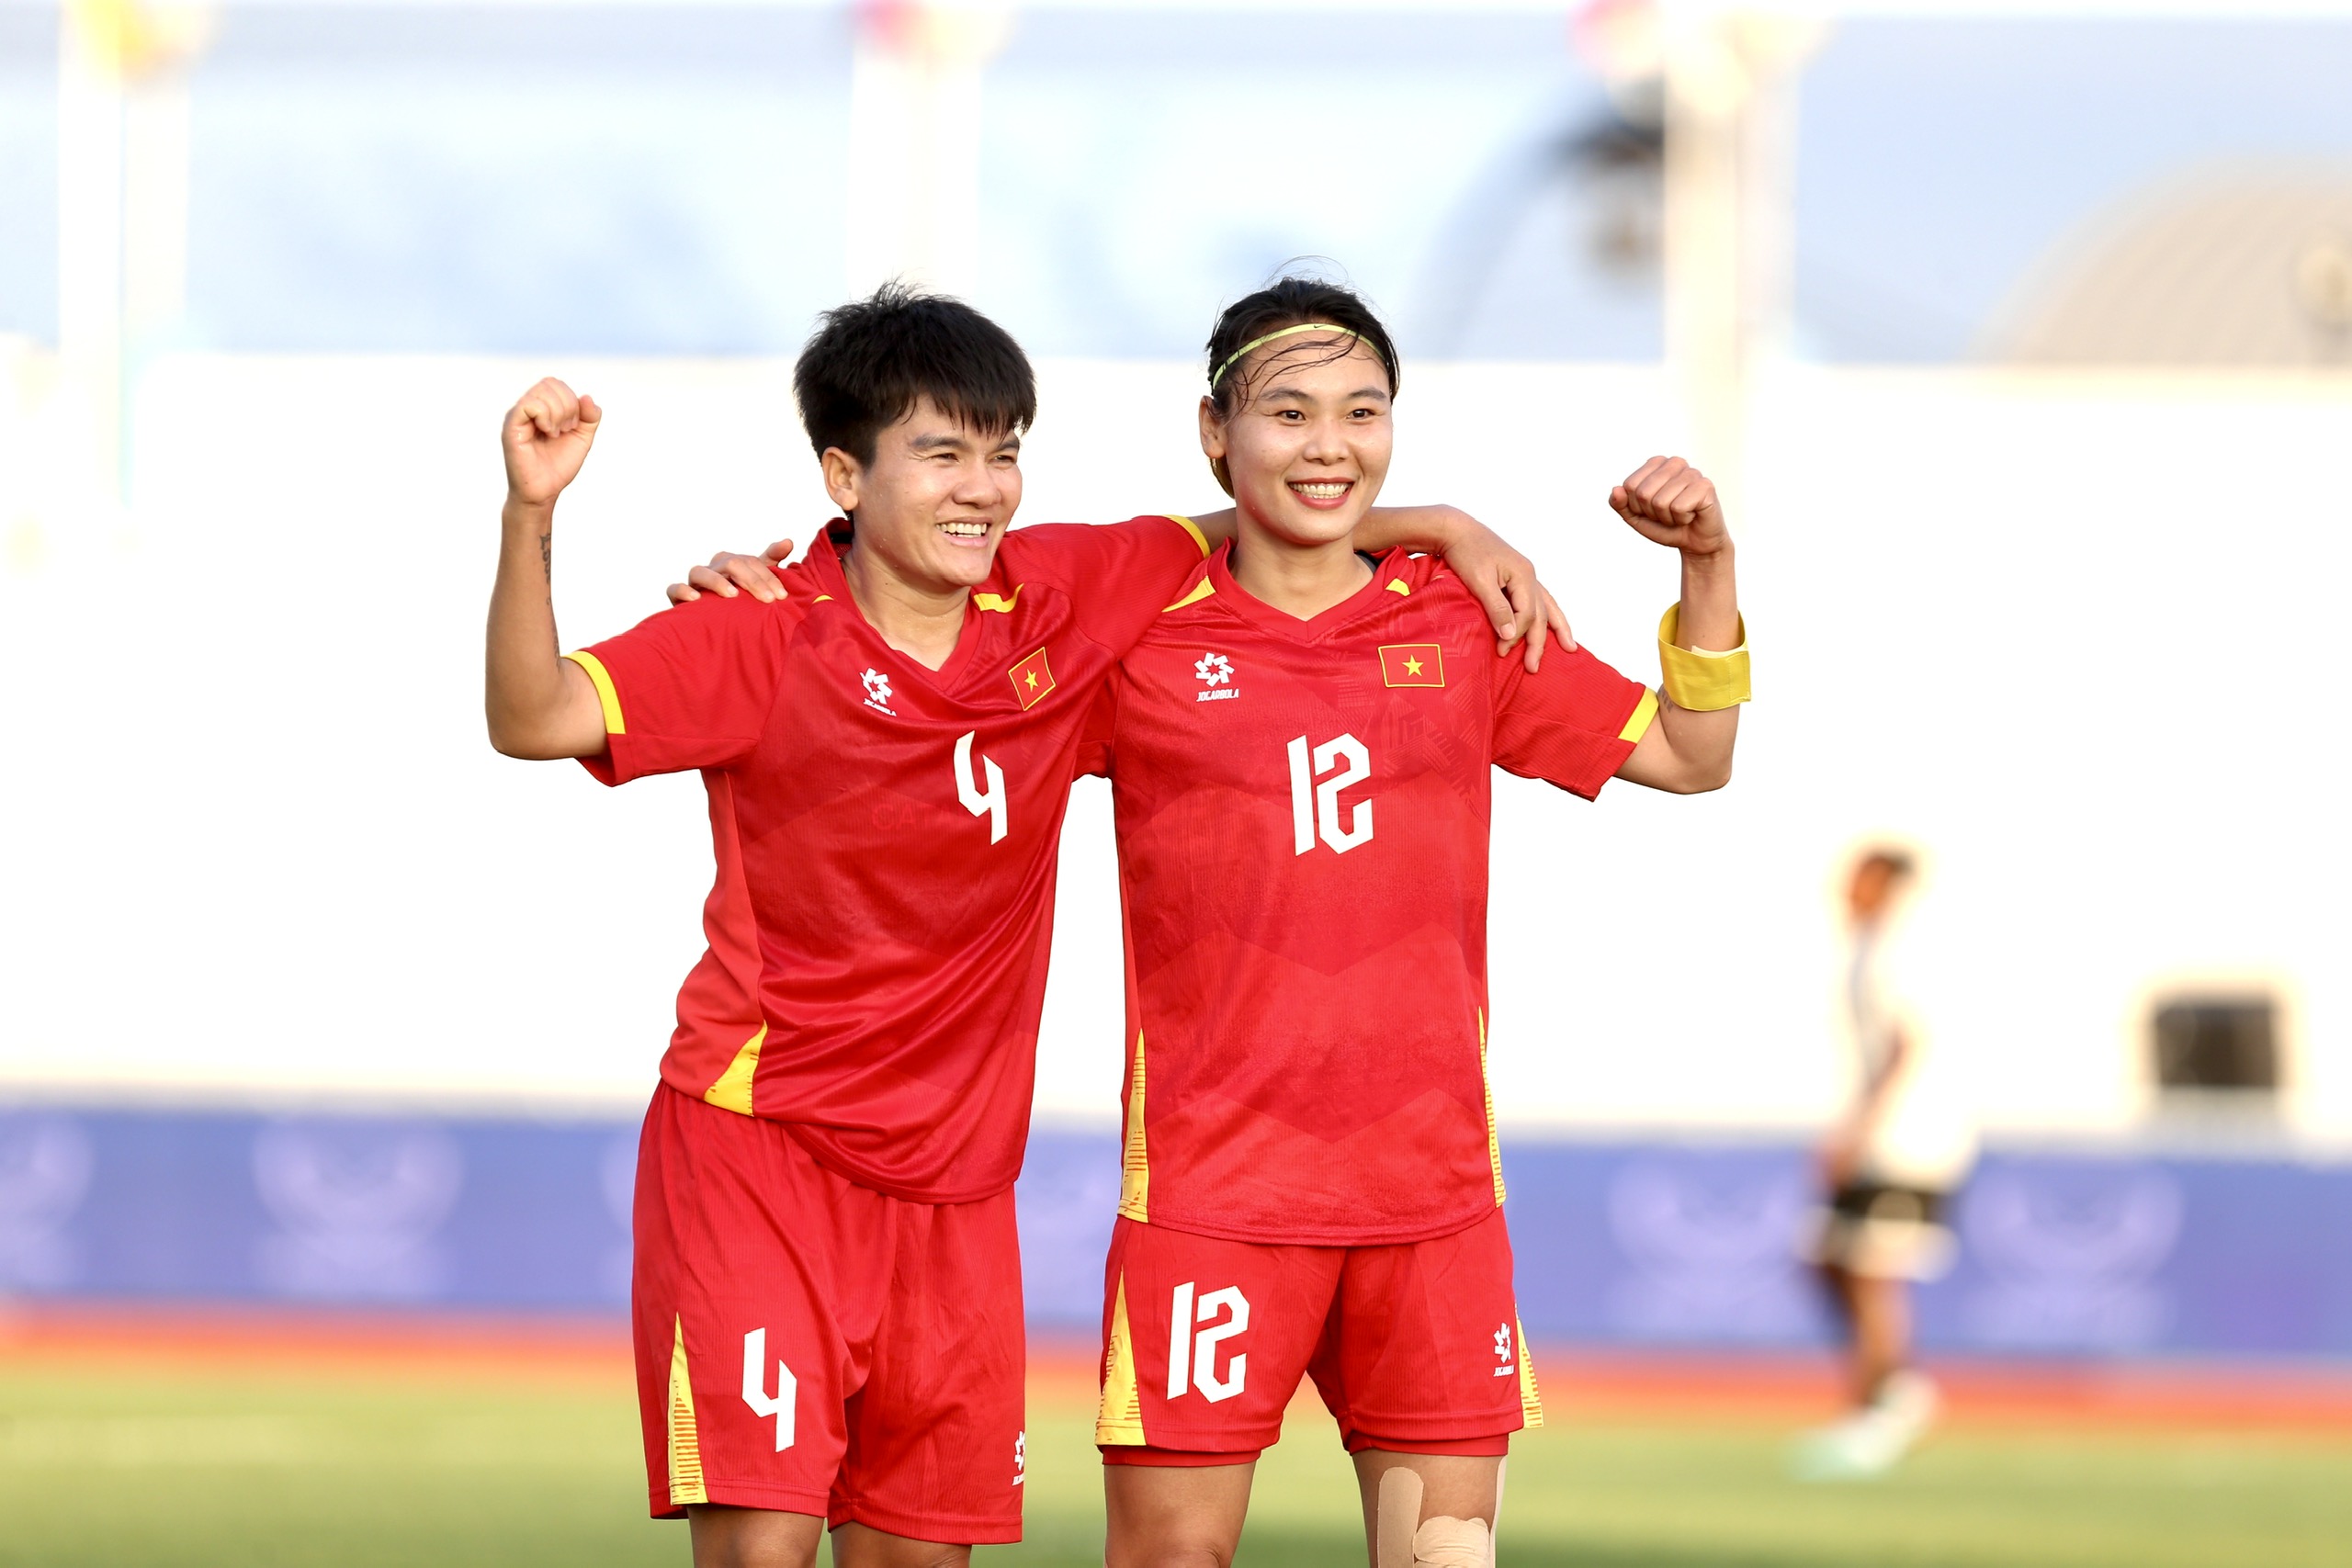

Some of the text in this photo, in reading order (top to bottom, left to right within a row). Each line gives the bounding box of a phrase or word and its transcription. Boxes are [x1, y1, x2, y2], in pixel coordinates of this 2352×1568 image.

[1195, 687, 1239, 703] JOGARBOLA
[953, 730, 1008, 846] 4
[1286, 732, 1374, 857] 12
[741, 1326, 797, 1453] 4
[1166, 1280, 1250, 1404] 12
